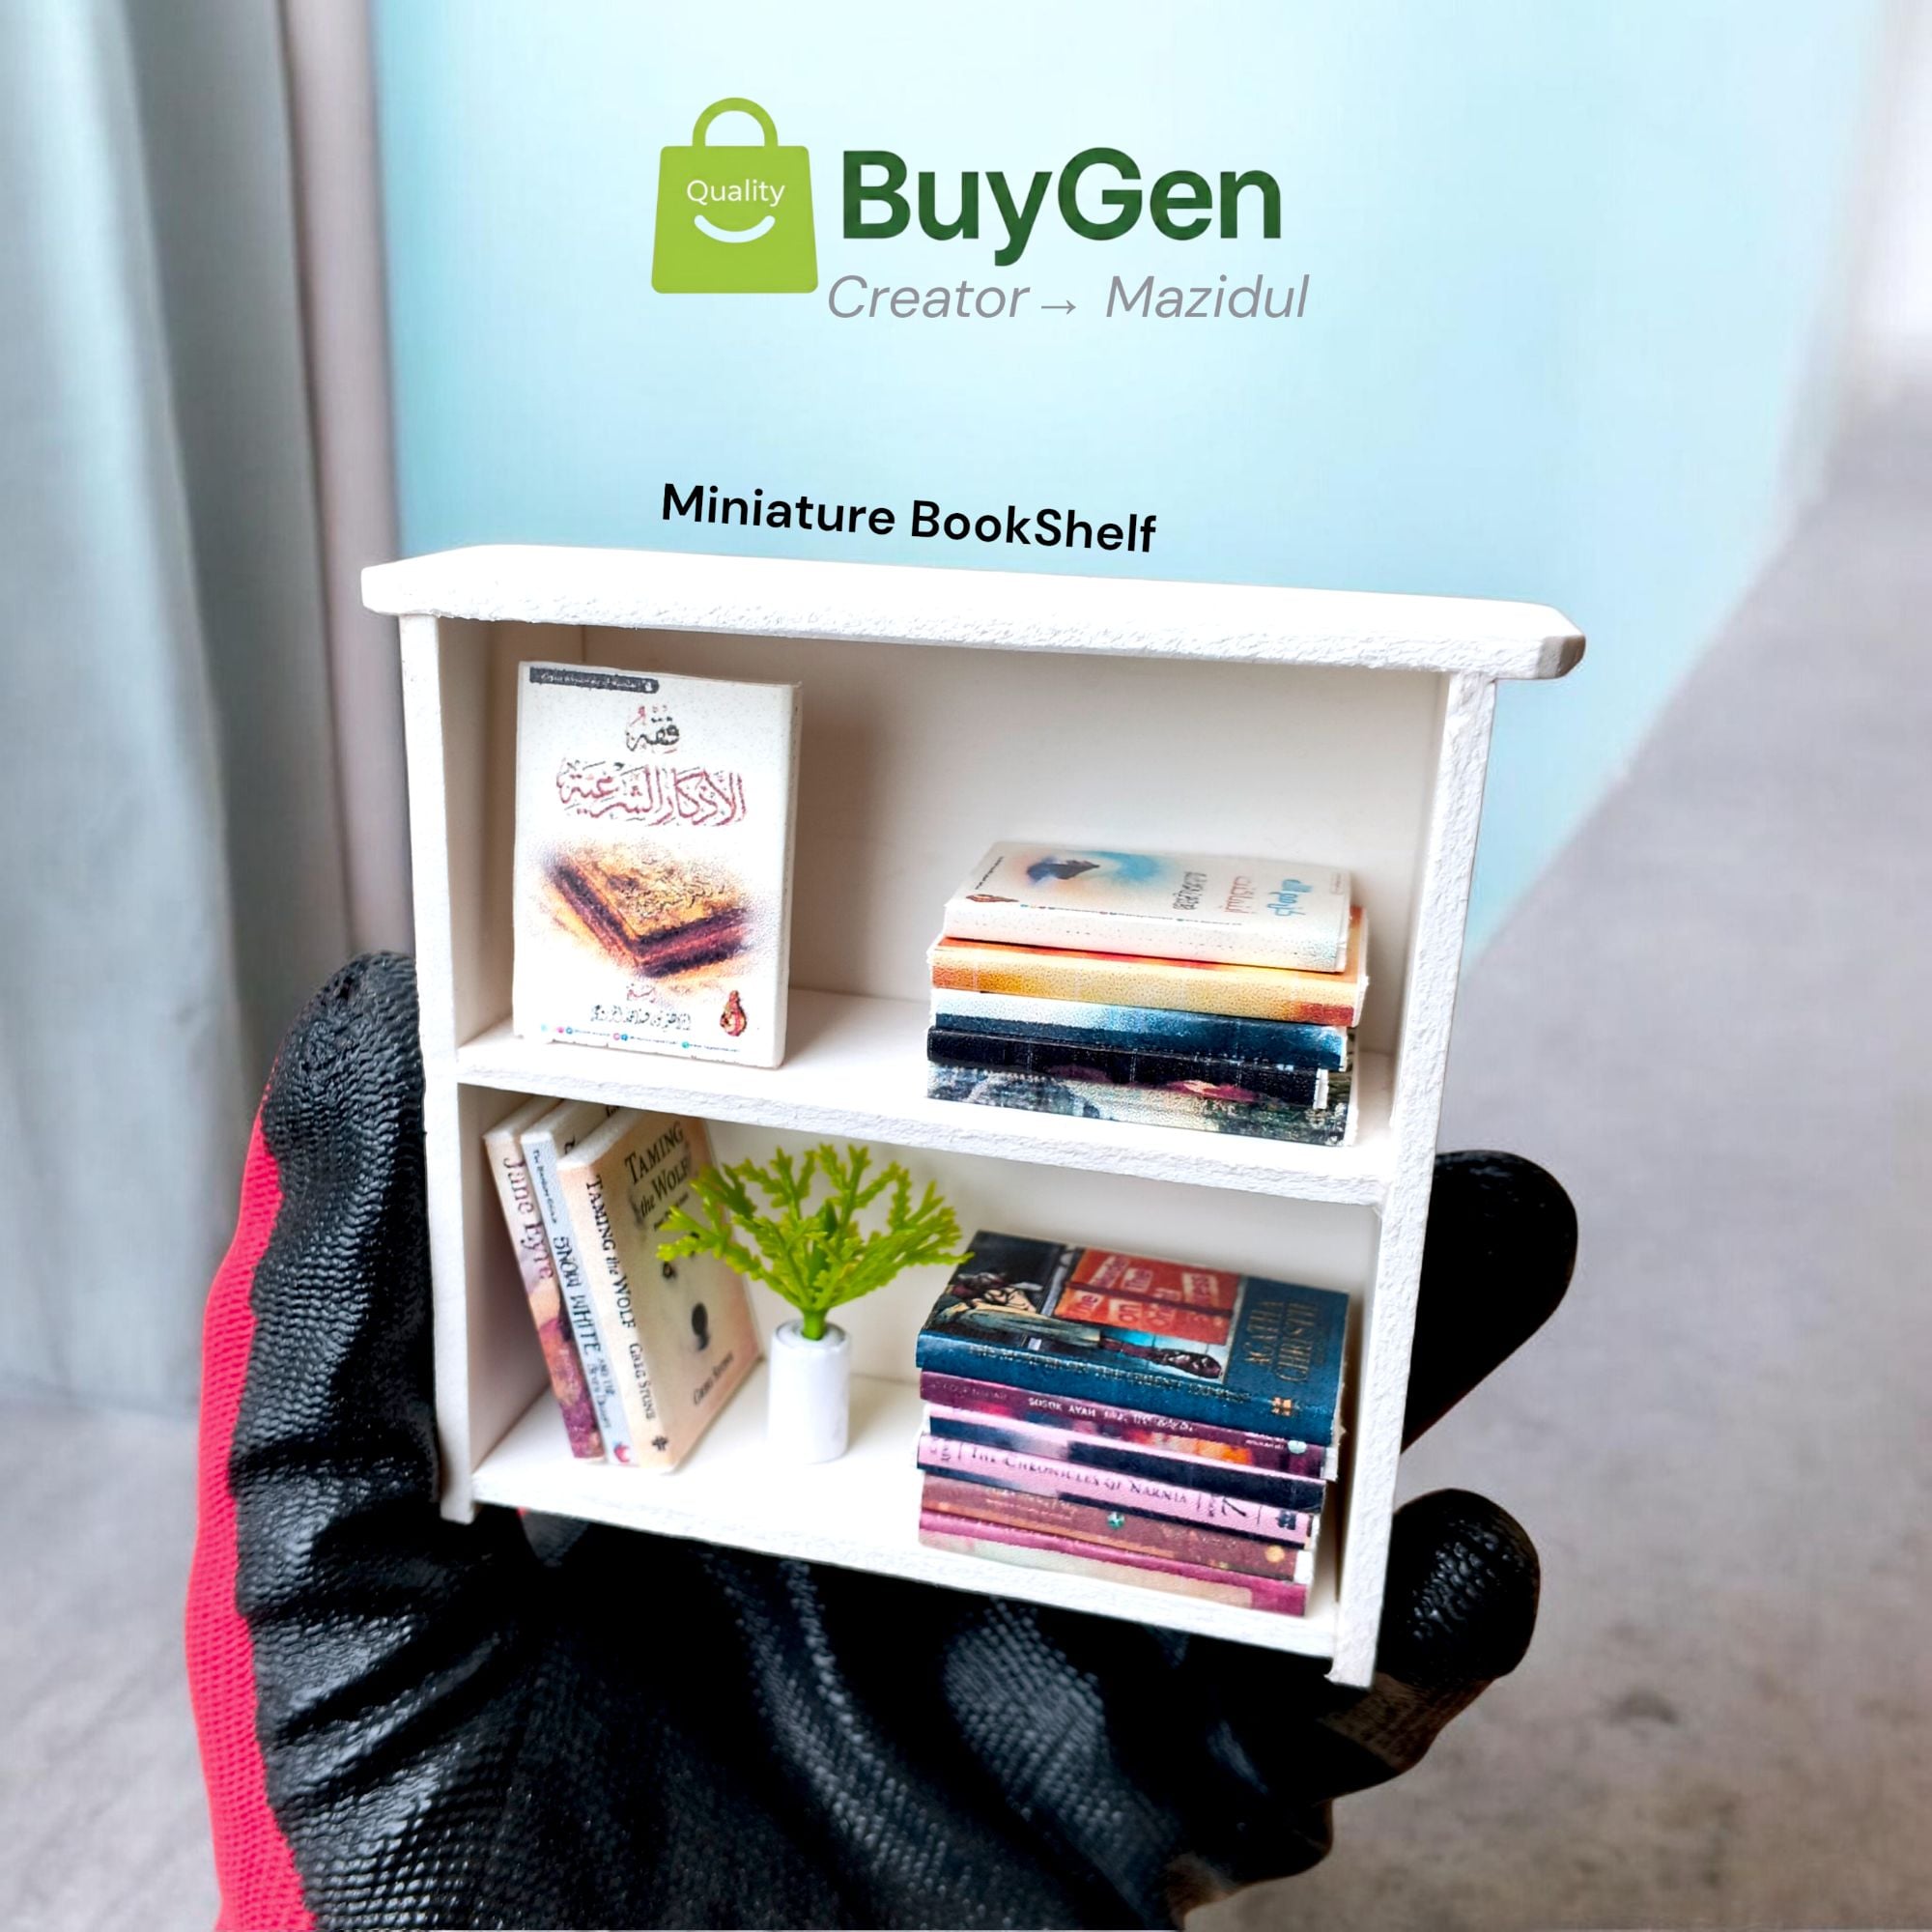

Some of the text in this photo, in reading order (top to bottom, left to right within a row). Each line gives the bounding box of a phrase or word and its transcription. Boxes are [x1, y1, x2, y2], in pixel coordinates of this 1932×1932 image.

[624, 1121, 684, 1185] TAMING
[553, 1236, 602, 1355] SNOW WHITE
[585, 1174, 616, 1251] TAMING
[612, 1274, 637, 1329] WOLF
[1129, 1480, 1188, 1504] NARNIA
